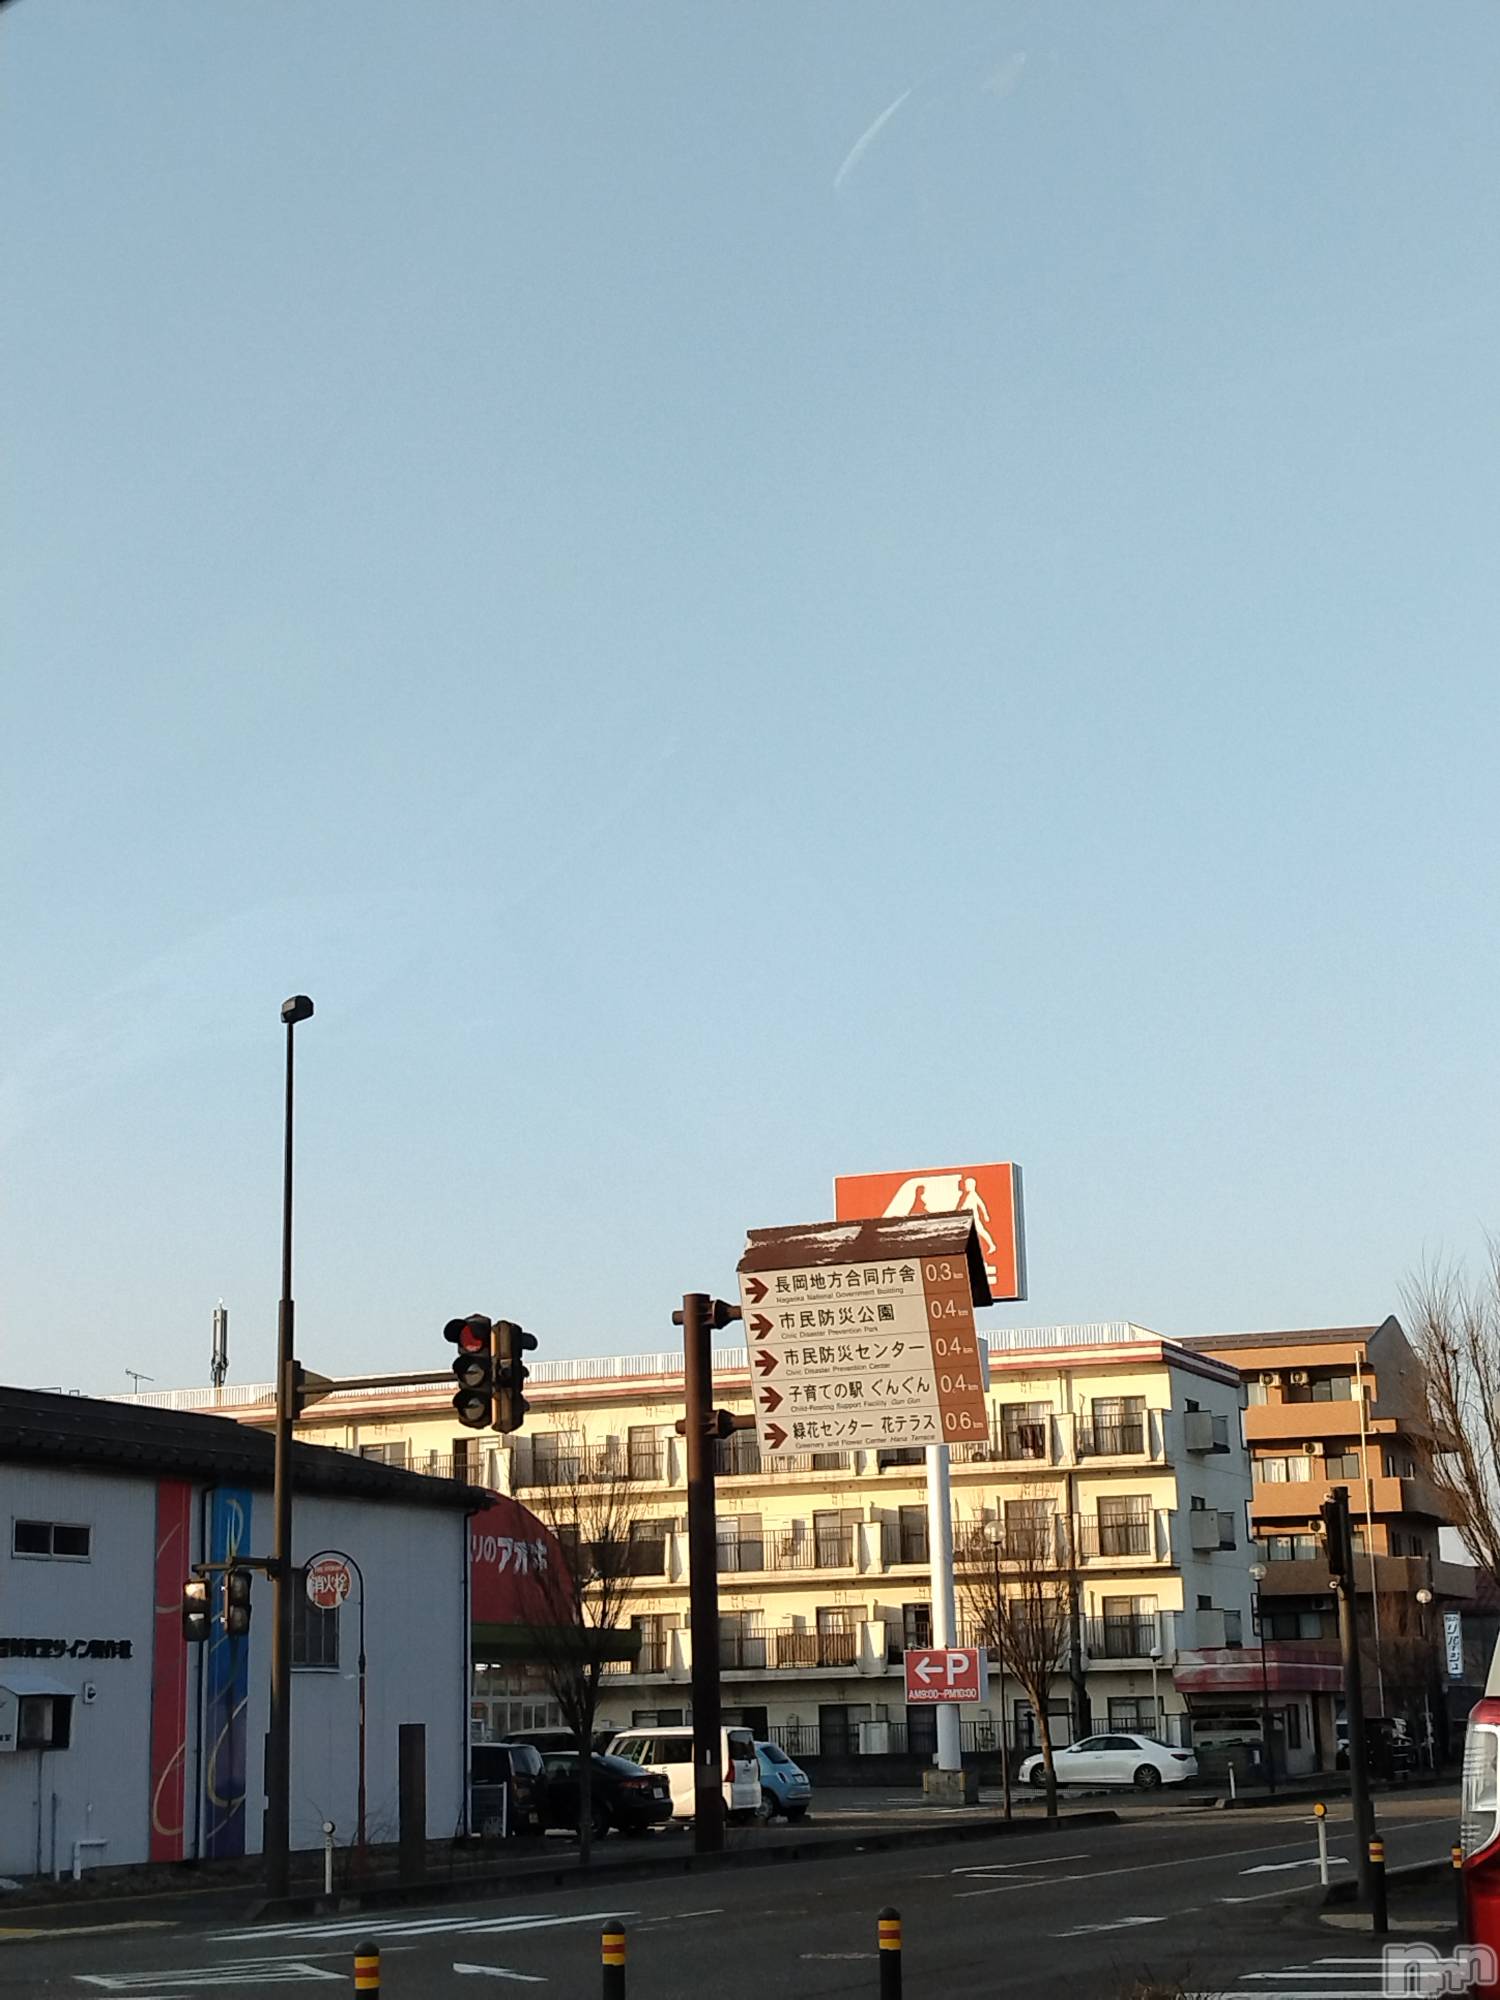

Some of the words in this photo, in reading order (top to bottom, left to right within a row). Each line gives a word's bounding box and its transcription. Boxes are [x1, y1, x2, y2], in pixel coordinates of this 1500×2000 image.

[775, 1265, 915, 1294] 長岡地方合同庁舎
[807, 1292, 833, 1301] National
[836, 1289, 875, 1299] Government
[877, 1286, 904, 1296] Building
[779, 1304, 895, 1330] 市民防災公園
[781, 1332, 797, 1340] Civic
[800, 1330, 826, 1338] Disaster
[828, 1327, 862, 1336] Prevention
[864, 1325, 879, 1333] Park
[784, 1340, 925, 1365] 市民防災センター
[786, 1368, 802, 1376] Civic
[804, 1366, 831, 1375] Disaster
[833, 1364, 867, 1373] Prevention
[869, 1362, 891, 1370] Center
[788, 1380, 864, 1402] 子育ての駅
[870, 1376, 930, 1397] ぐんぐん
[836, 1401, 862, 1410] Support
[864, 1399, 887, 1408] Facility
[891, 1398, 905, 1406] Gun
[907, 1397, 921, 1405] Gun
[792, 1418, 873, 1439] 緑花センター
[881, 1414, 936, 1433] 花テラス
[795, 1441, 825, 1449] Greenery
[827, 1439, 839, 1447] and
[841, 1437, 863, 1446] Flower
[865, 1436, 887, 1444] Center
[890, 1434, 908, 1443] Hana
[911, 1433, 936, 1442] Terrace
[311, 1572, 348, 1592] 消火栓
[946, 1653, 969, 1685] P
